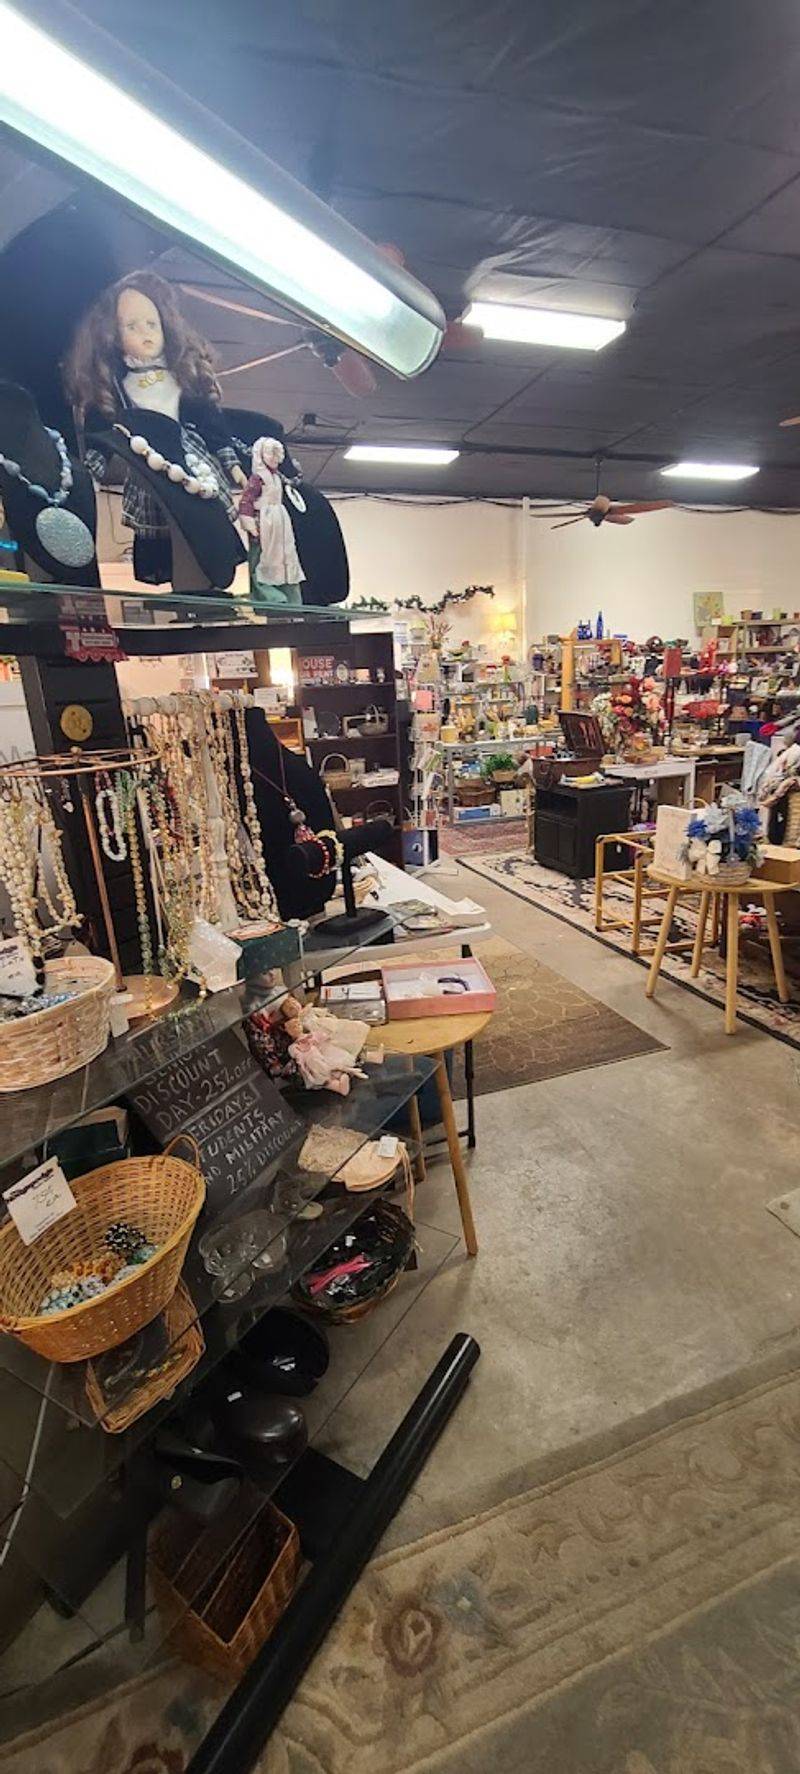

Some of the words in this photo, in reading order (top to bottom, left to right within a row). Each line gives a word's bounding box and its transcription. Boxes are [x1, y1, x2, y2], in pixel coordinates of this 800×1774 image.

[303, 658, 333, 670] OUSE
[134, 1048, 222, 1113] DISCOUNT
[188, 1090, 254, 1137] FRIDAYS
[200, 1107, 266, 1162] TUDENTS
[204, 1166, 222, 1186] ND
[225, 1109, 284, 1165] MILITARY
[256, 1119, 305, 1167] DISCOUNT
